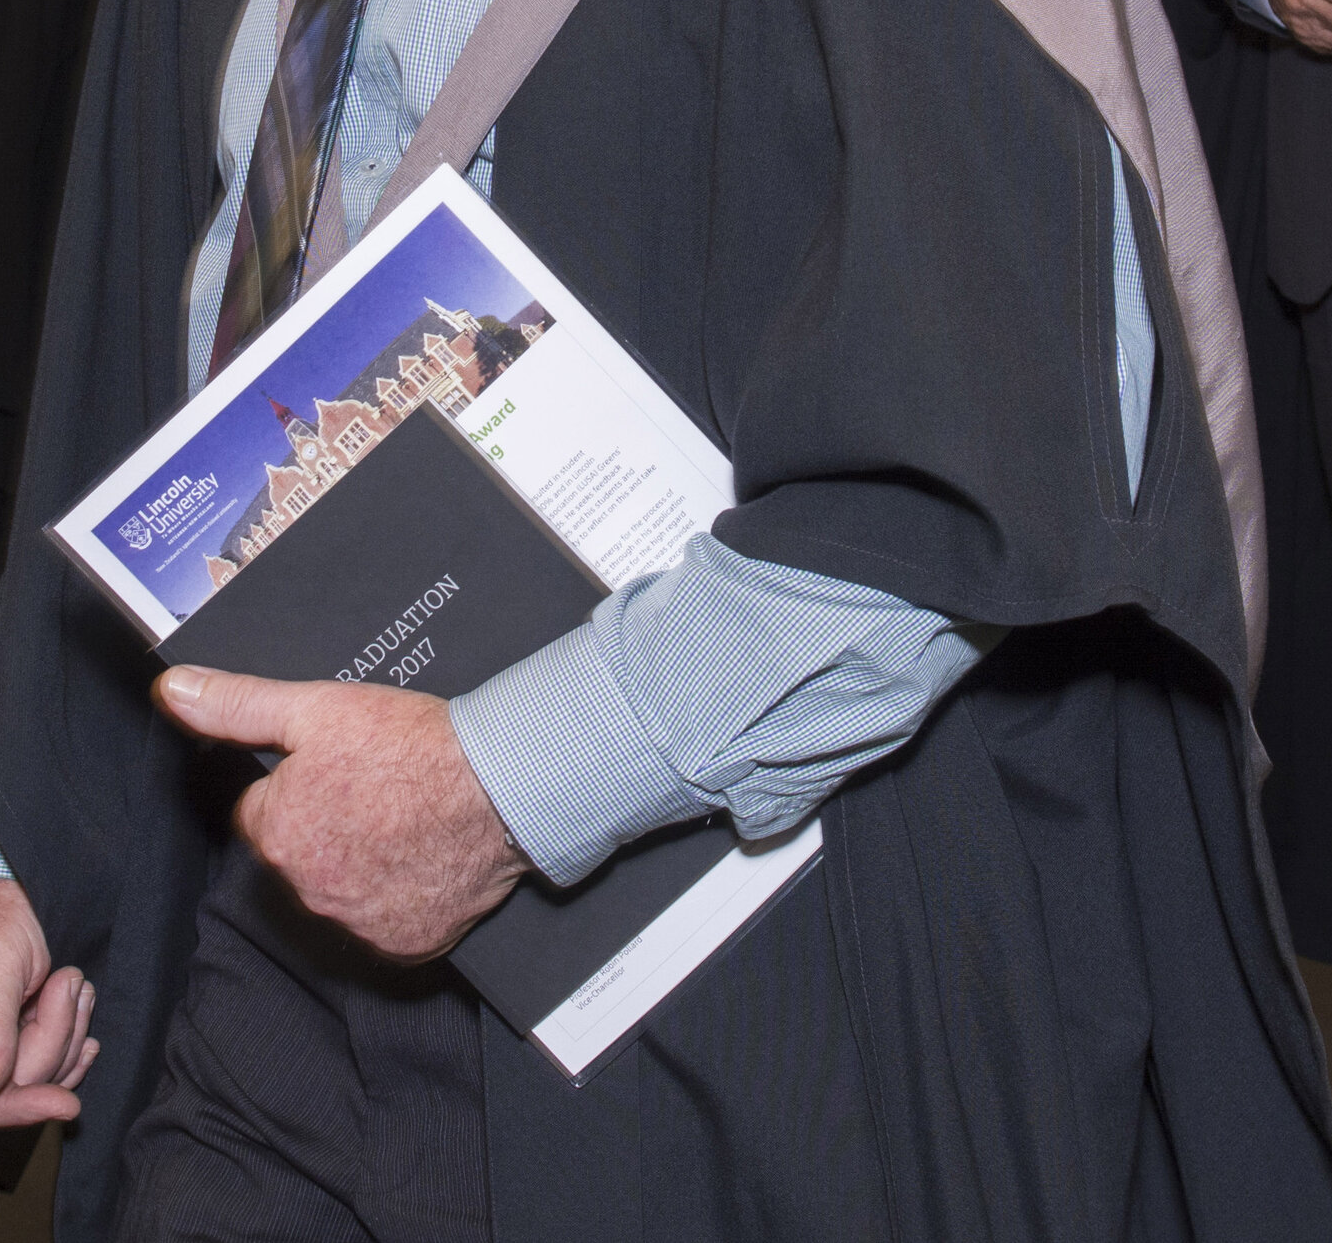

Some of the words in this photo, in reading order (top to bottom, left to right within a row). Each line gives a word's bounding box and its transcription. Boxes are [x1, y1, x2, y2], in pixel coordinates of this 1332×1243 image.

[467, 398, 516, 445] Award
[551, 473, 561, 482] in
[559, 449, 585, 475] student
[552, 483, 567, 499] and
[563, 477, 574, 487] in
[571, 457, 595, 480] Lincoln
[564, 508, 576, 520] He
[574, 491, 594, 511] seeks
[592, 463, 622, 493] feedback
[575, 469, 599, 492] (LUSA)
[138, 475, 193, 523] Lincoln
[149, 472, 219, 539] University
[571, 515, 586, 531] and
[583, 506, 596, 518] his
[593, 480, 623, 508] students
[621, 467, 636, 482] and
[578, 530, 589, 540] to
[586, 510, 609, 533] reflect
[606, 502, 618, 513] on
[615, 490, 630, 505] this
[628, 477, 643, 493] and
[640, 463, 657, 480] take
[599, 539, 623, 563] energy
[620, 529, 632, 542] for
[629, 519, 644, 533] the
[641, 496, 668, 522] process
[665, 488, 675, 499] of
[608, 544, 636, 570] through
[633, 537, 643, 546] in
[640, 527, 653, 540] his
[650, 494, 687, 530] application
[628, 555, 641, 567] for
[638, 544, 653, 558] the
[649, 530, 667, 547] high
[664, 510, 688, 533] regard
[653, 545, 669, 561] was
[666, 517, 698, 549] provided.
[389, 637, 435, 686] 2017
[568, 972, 601, 1003] Professor
[598, 955, 620, 976] Robin
[617, 934, 643, 959] Pollard
[575, 965, 626, 1011] Vice-Chancellor
